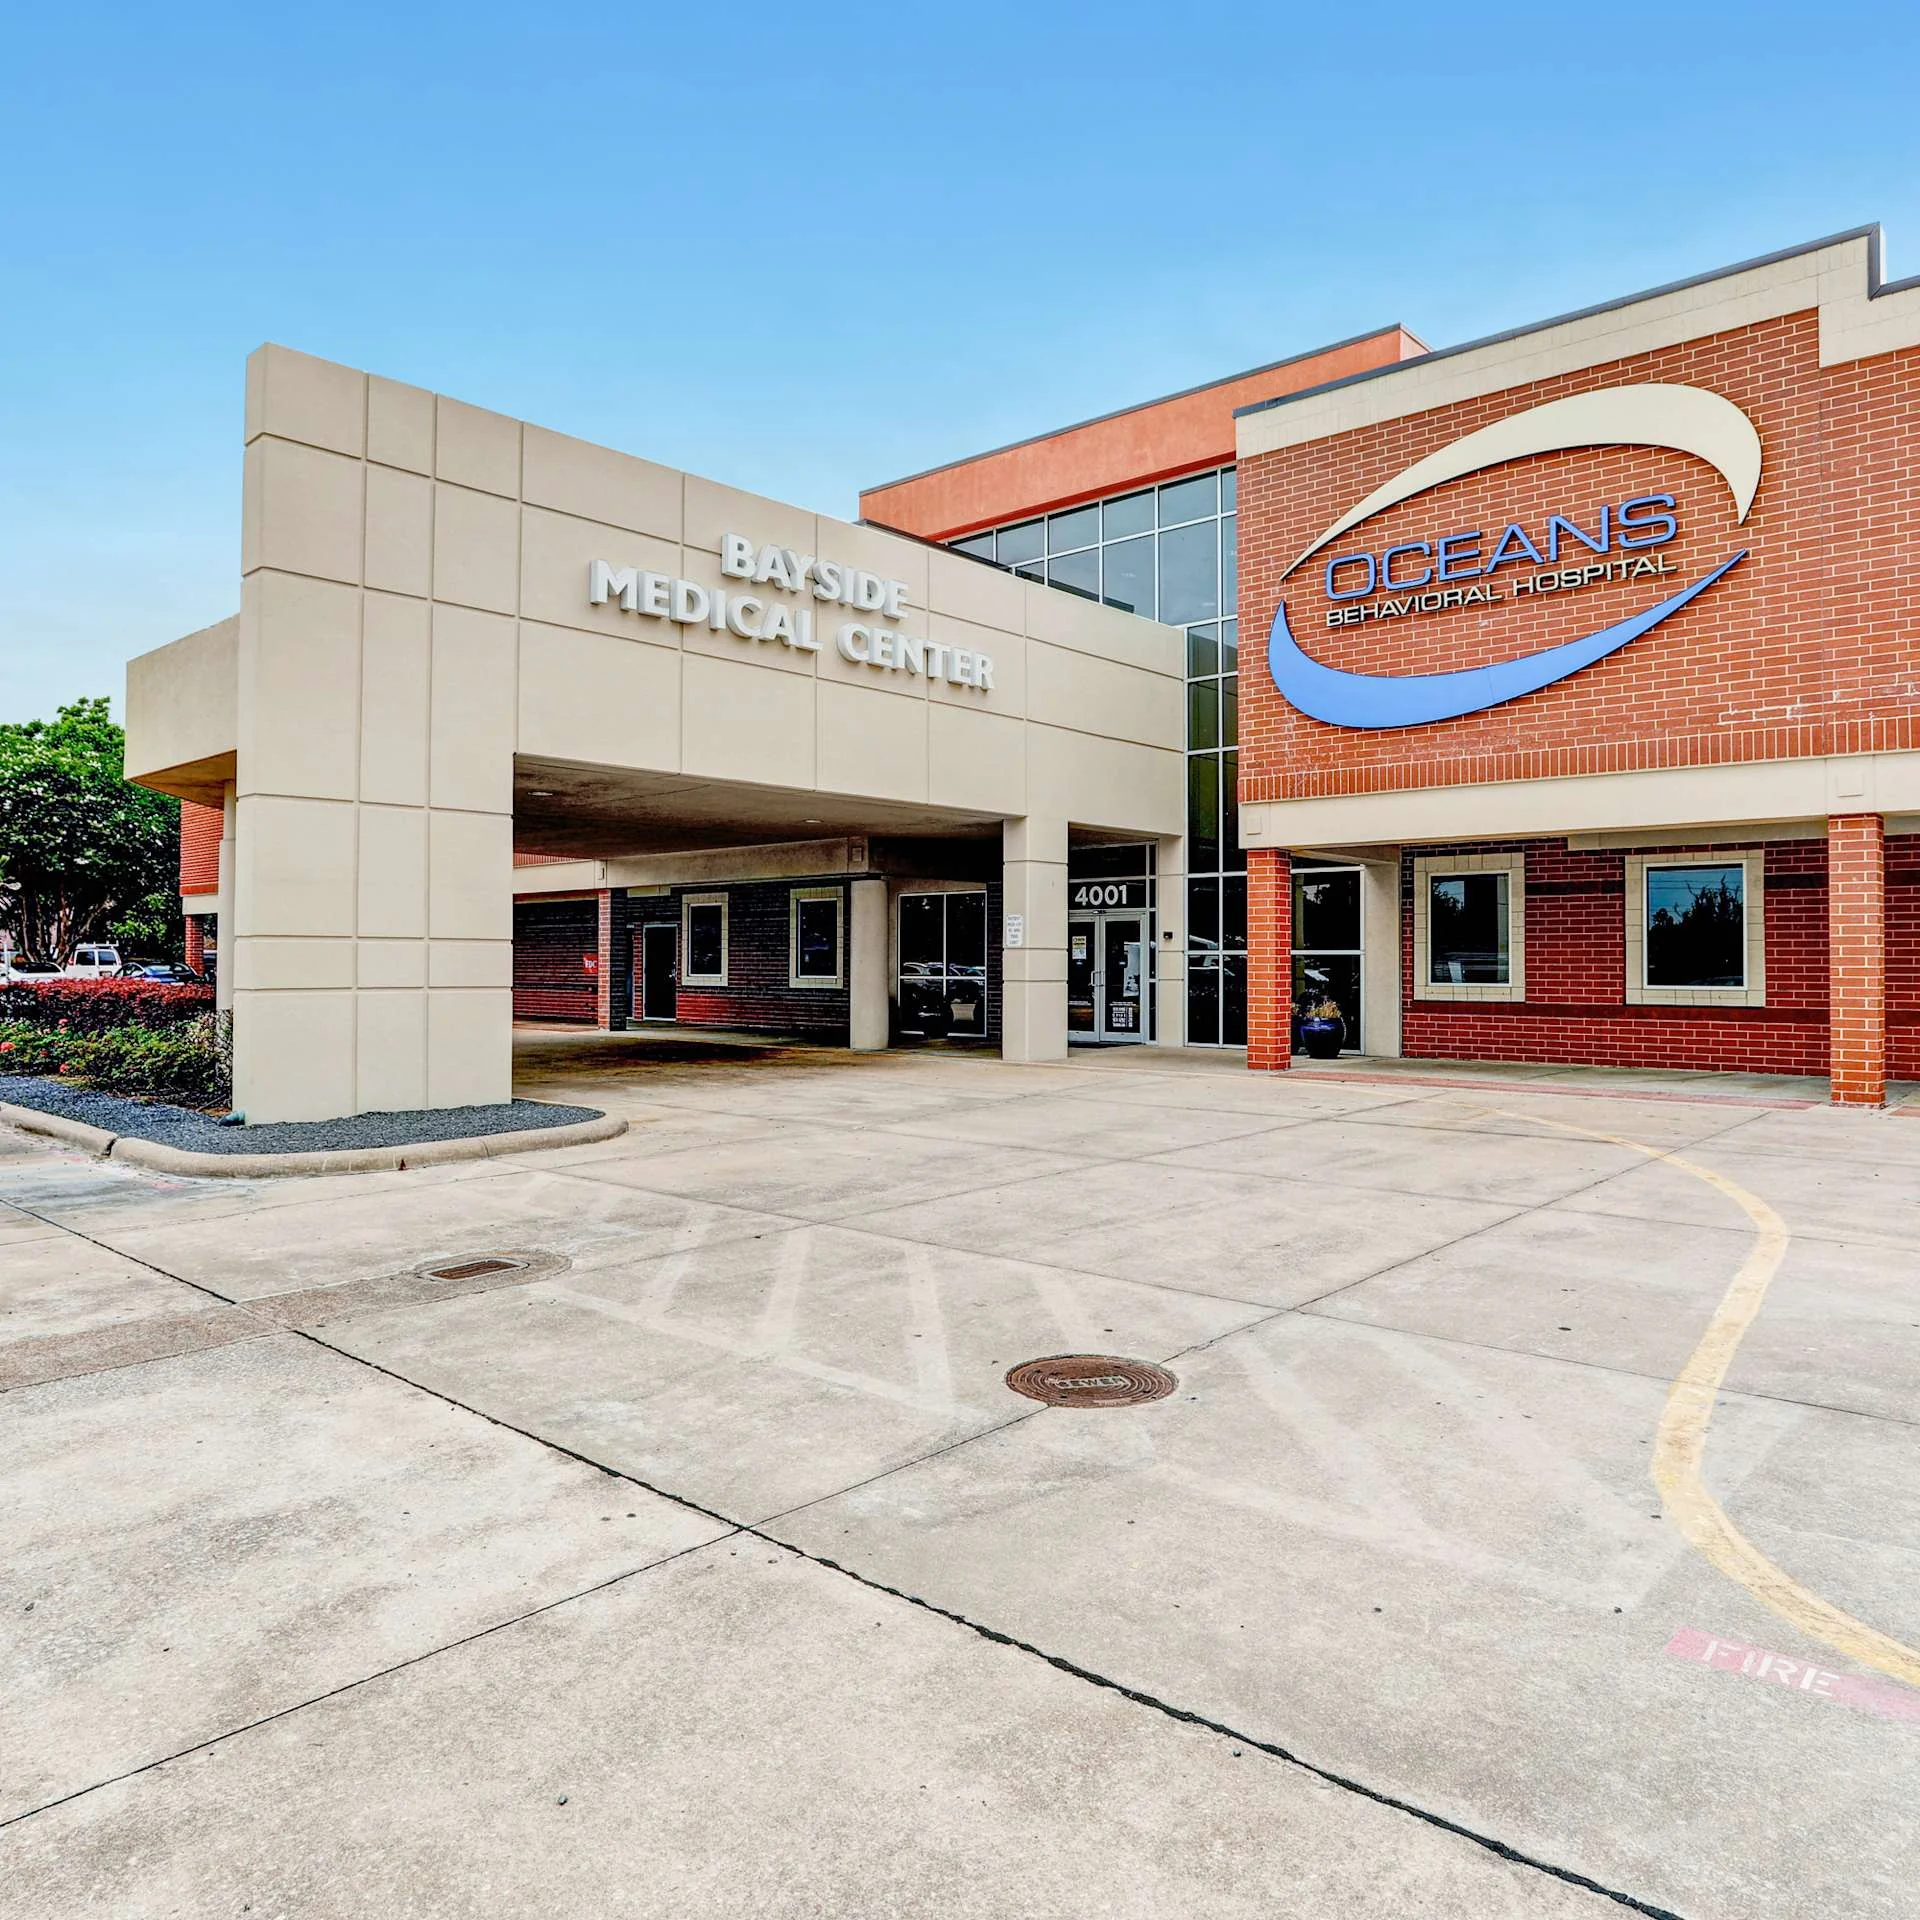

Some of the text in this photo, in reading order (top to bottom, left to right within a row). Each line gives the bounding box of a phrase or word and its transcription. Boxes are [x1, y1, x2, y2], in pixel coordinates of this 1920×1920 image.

[720, 532, 911, 621] BAYSIDE
[1325, 493, 1679, 600] OCEANS
[589, 558, 995, 692] MEDICAL CENTER
[1326, 552, 1677, 628] BEHAVIORAL HOSPITAL
[1074, 884, 1128, 906] 4001
[1700, 1640, 1840, 1696] FIRE
